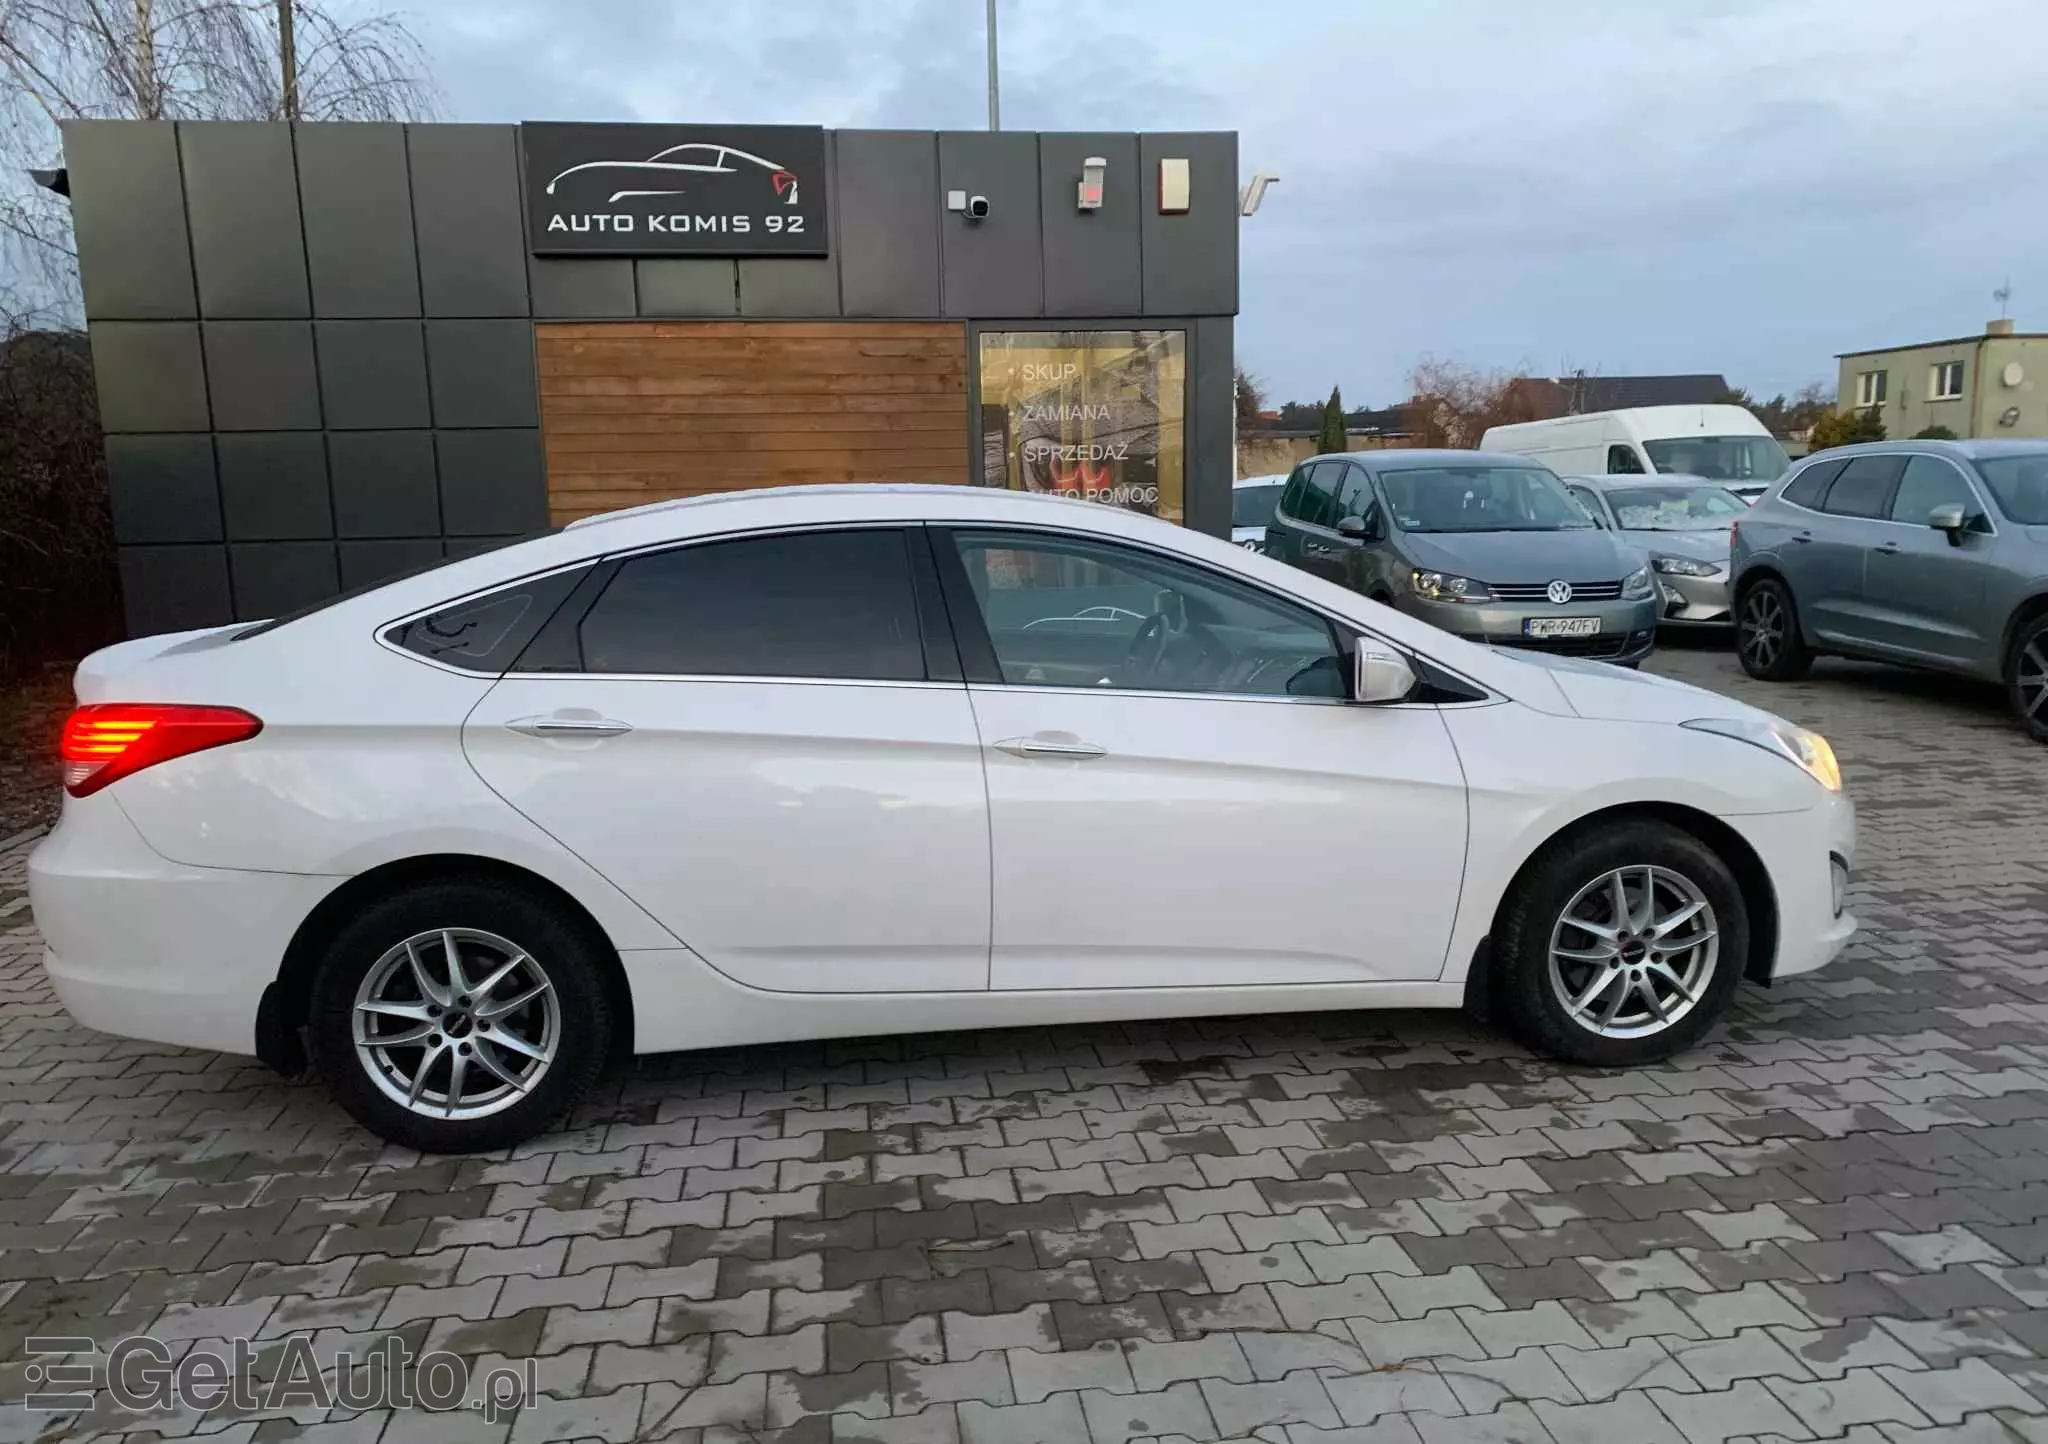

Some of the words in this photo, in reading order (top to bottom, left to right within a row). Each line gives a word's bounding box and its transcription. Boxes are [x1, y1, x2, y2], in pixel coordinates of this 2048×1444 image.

[547, 214, 634, 232] AUTO
[648, 214, 751, 233] KOMIS
[764, 214, 805, 233] 92
[1022, 363, 1077, 381] SKUP
[1022, 404, 1111, 421] ZAMIANA
[1024, 442, 1129, 462] SPRZEDAŻ
[1086, 486, 1159, 503] POMOC
